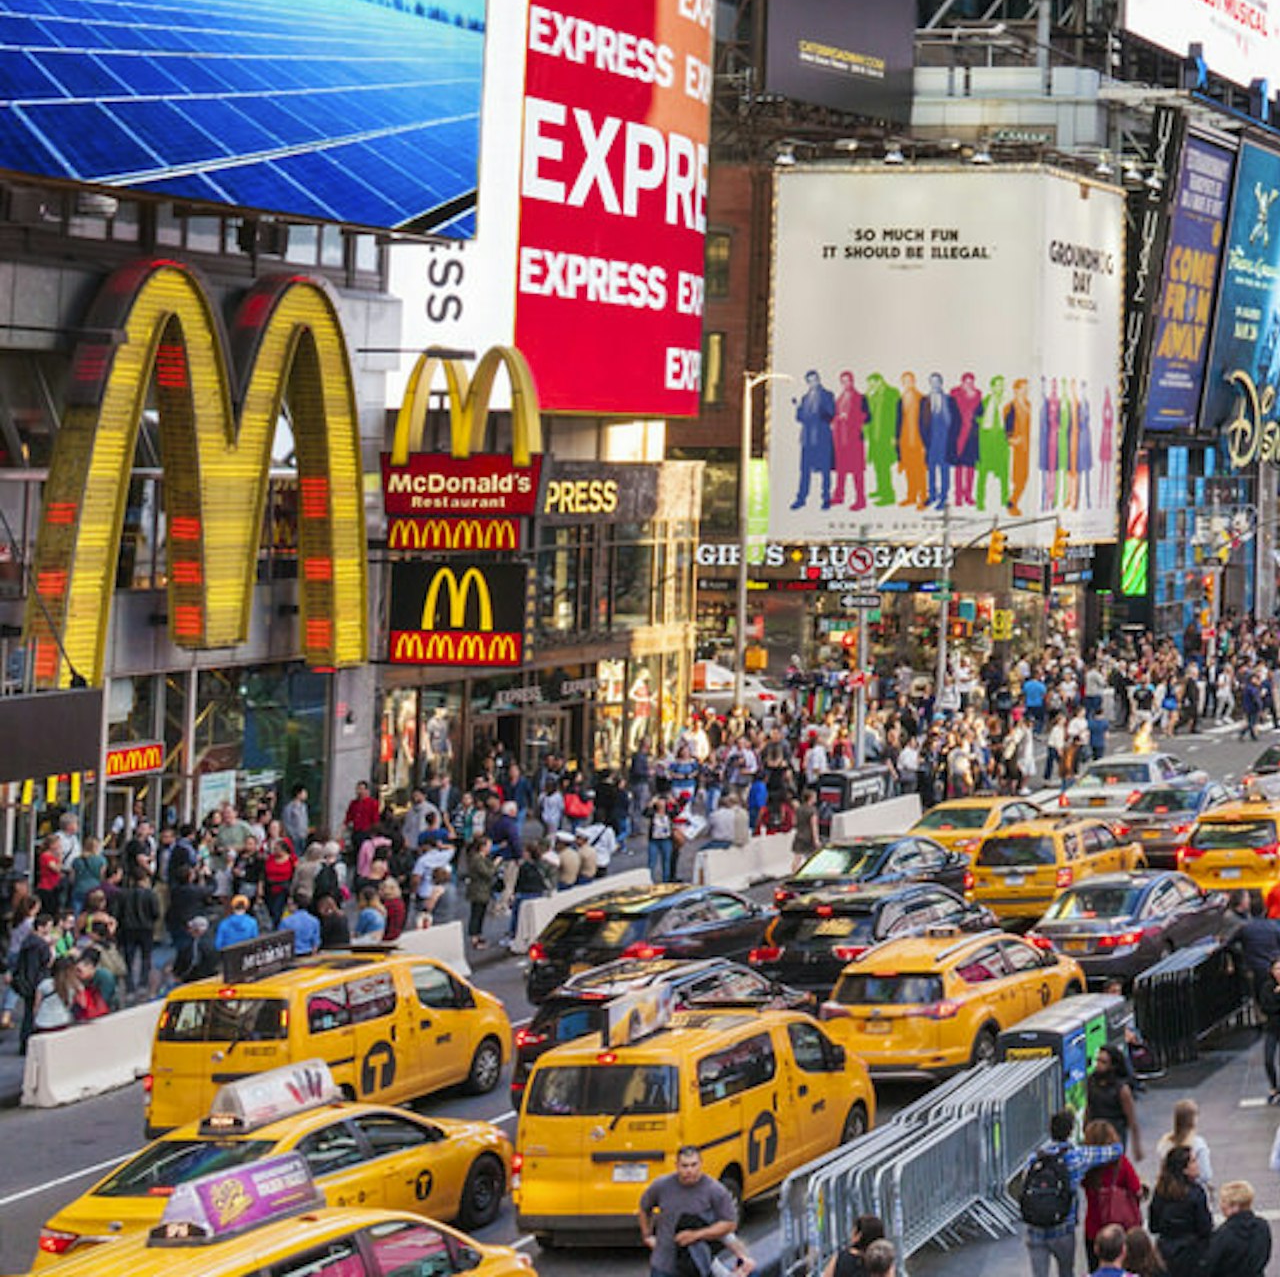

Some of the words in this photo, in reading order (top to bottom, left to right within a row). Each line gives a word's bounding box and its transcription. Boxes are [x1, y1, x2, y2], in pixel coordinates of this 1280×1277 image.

[529, 4, 674, 88] EXPRESS
[883, 228, 924, 242] MUCH
[931, 228, 959, 242] FUN
[822, 245, 838, 260] IT
[844, 245, 901, 260] SHOULD
[905, 245, 924, 260] BE
[519, 246, 667, 312] EXPRESS
[1169, 245, 1217, 289] COME
[388, 473, 532, 494] McDonald's
[545, 480, 618, 514] PRESS
[411, 495, 505, 509] Restaurant
